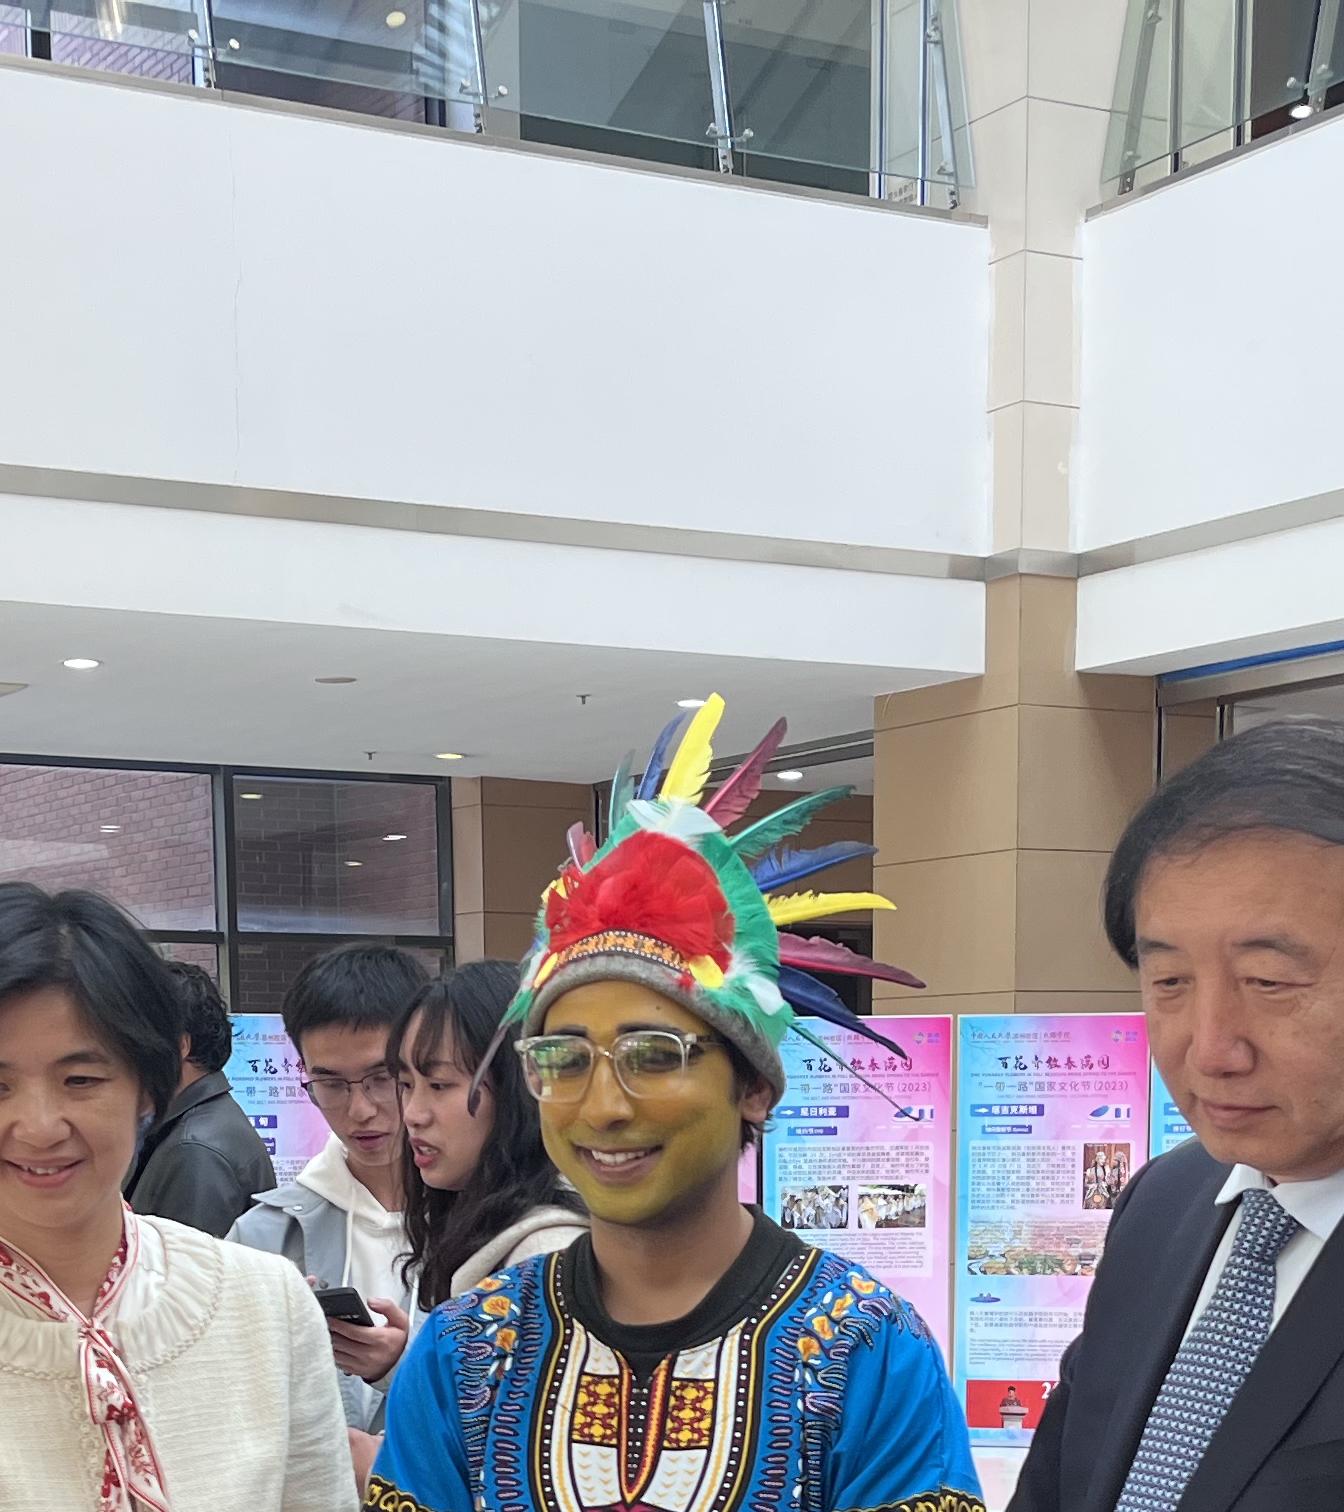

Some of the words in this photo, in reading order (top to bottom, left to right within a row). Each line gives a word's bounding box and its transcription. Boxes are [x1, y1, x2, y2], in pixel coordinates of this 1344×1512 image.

[799, 1106, 838, 1117] 尼日利亚
[991, 1105, 1038, 1115] 塔吉克斯坦
